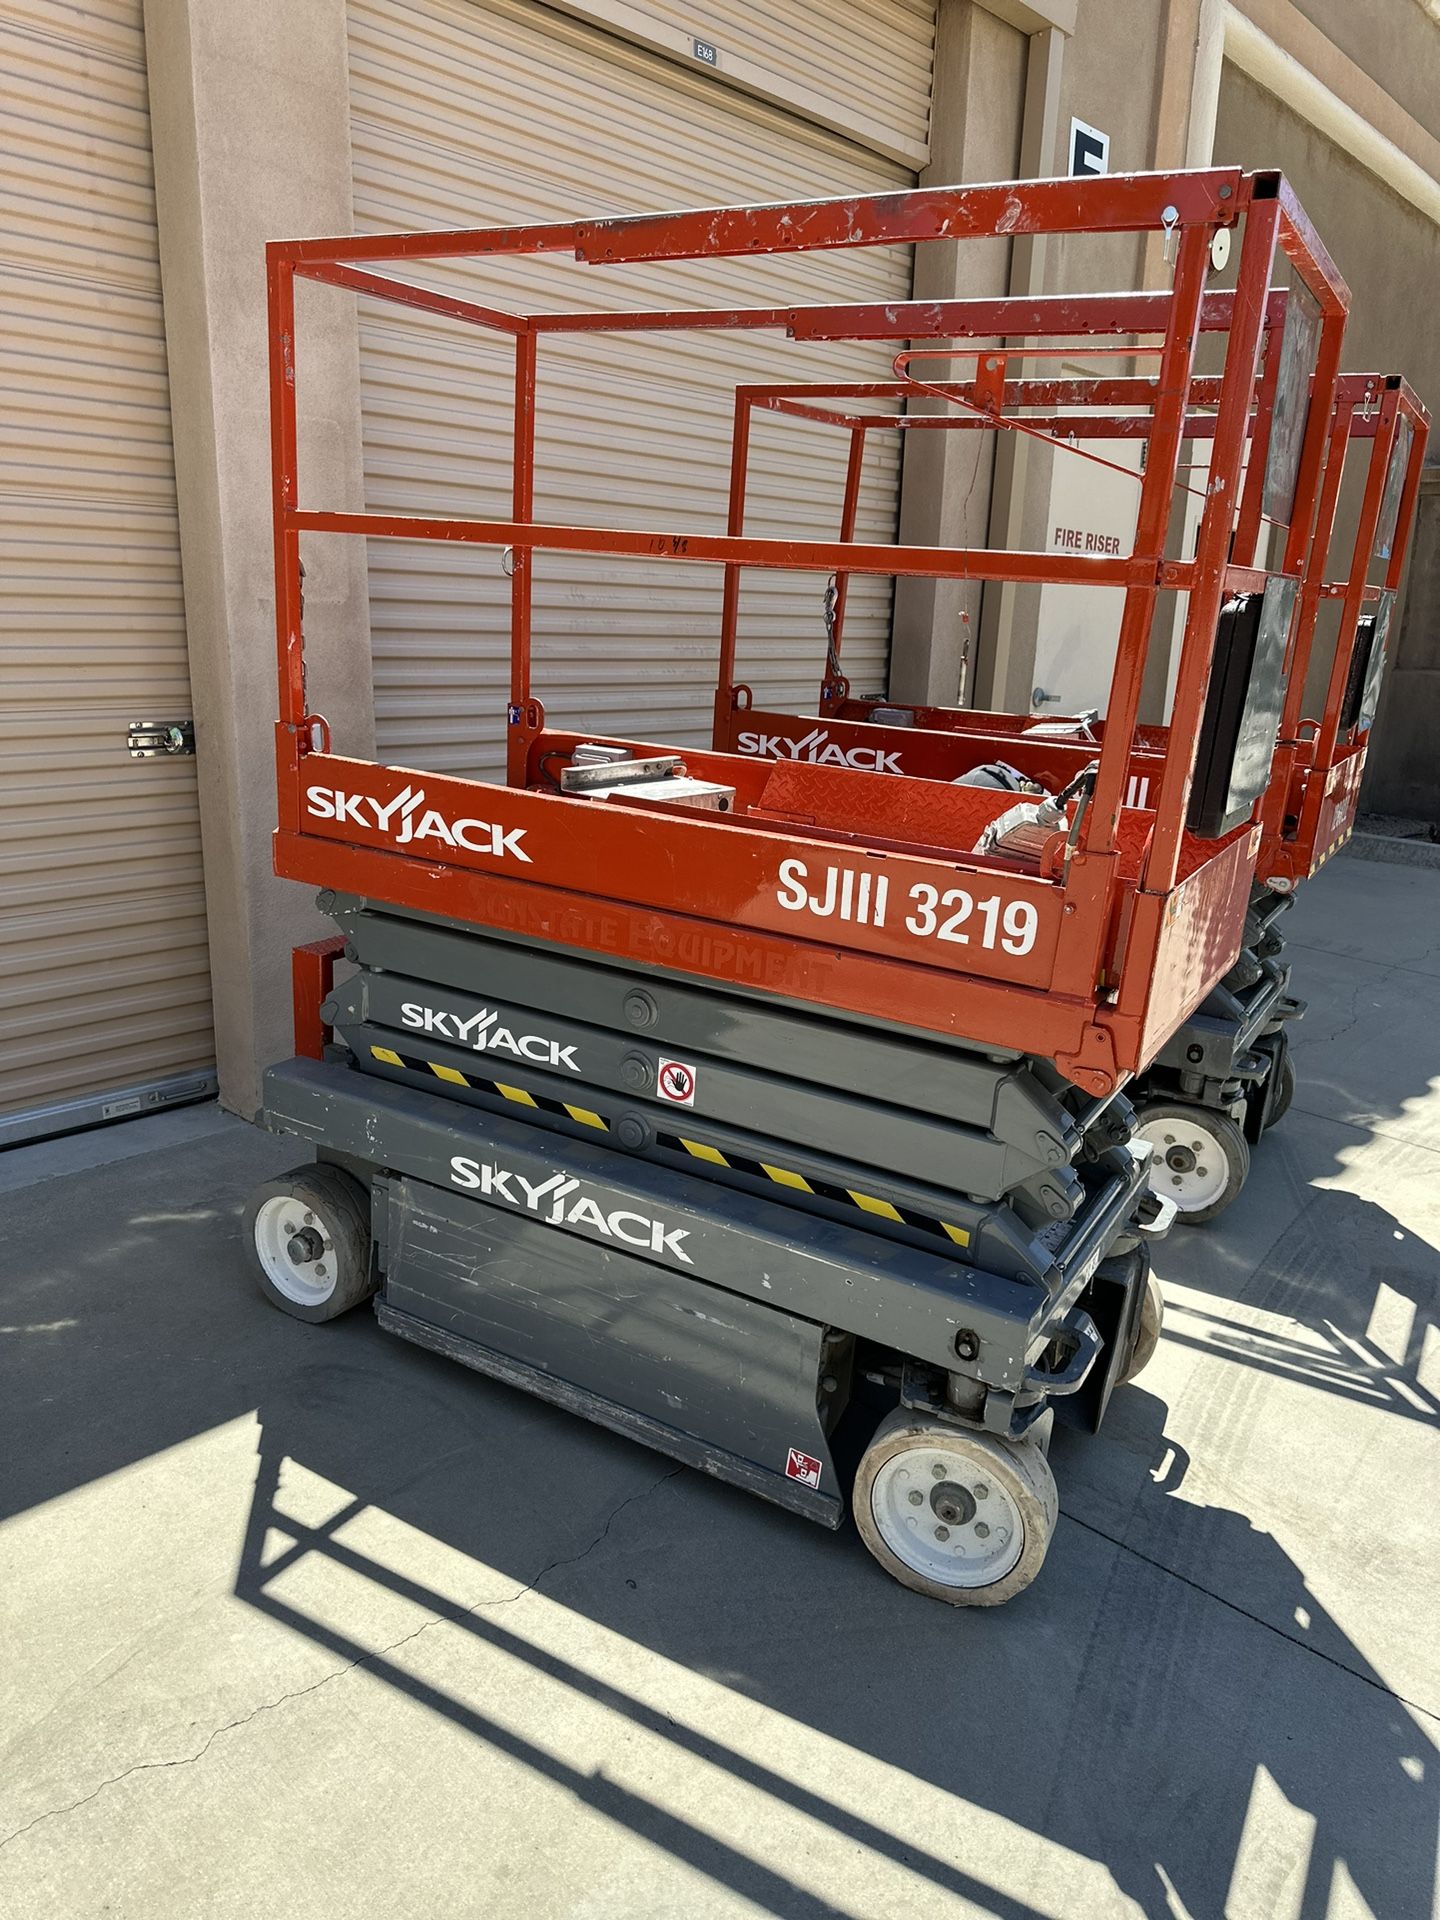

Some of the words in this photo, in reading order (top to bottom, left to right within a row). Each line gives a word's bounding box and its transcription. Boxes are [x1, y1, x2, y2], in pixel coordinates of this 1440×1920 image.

[696, 44, 713, 61] E168
[1054, 527, 1083, 549] FIRE
[1085, 533, 1120, 555] RISER
[737, 728, 905, 775] SKYJACK
[306, 784, 534, 864] SKYJACK
[776, 858, 889, 928] SJIII
[905, 882, 1039, 956] 3219
[401, 1003, 581, 1072] SKYJACK
[450, 1156, 695, 1265] SKYJACK
